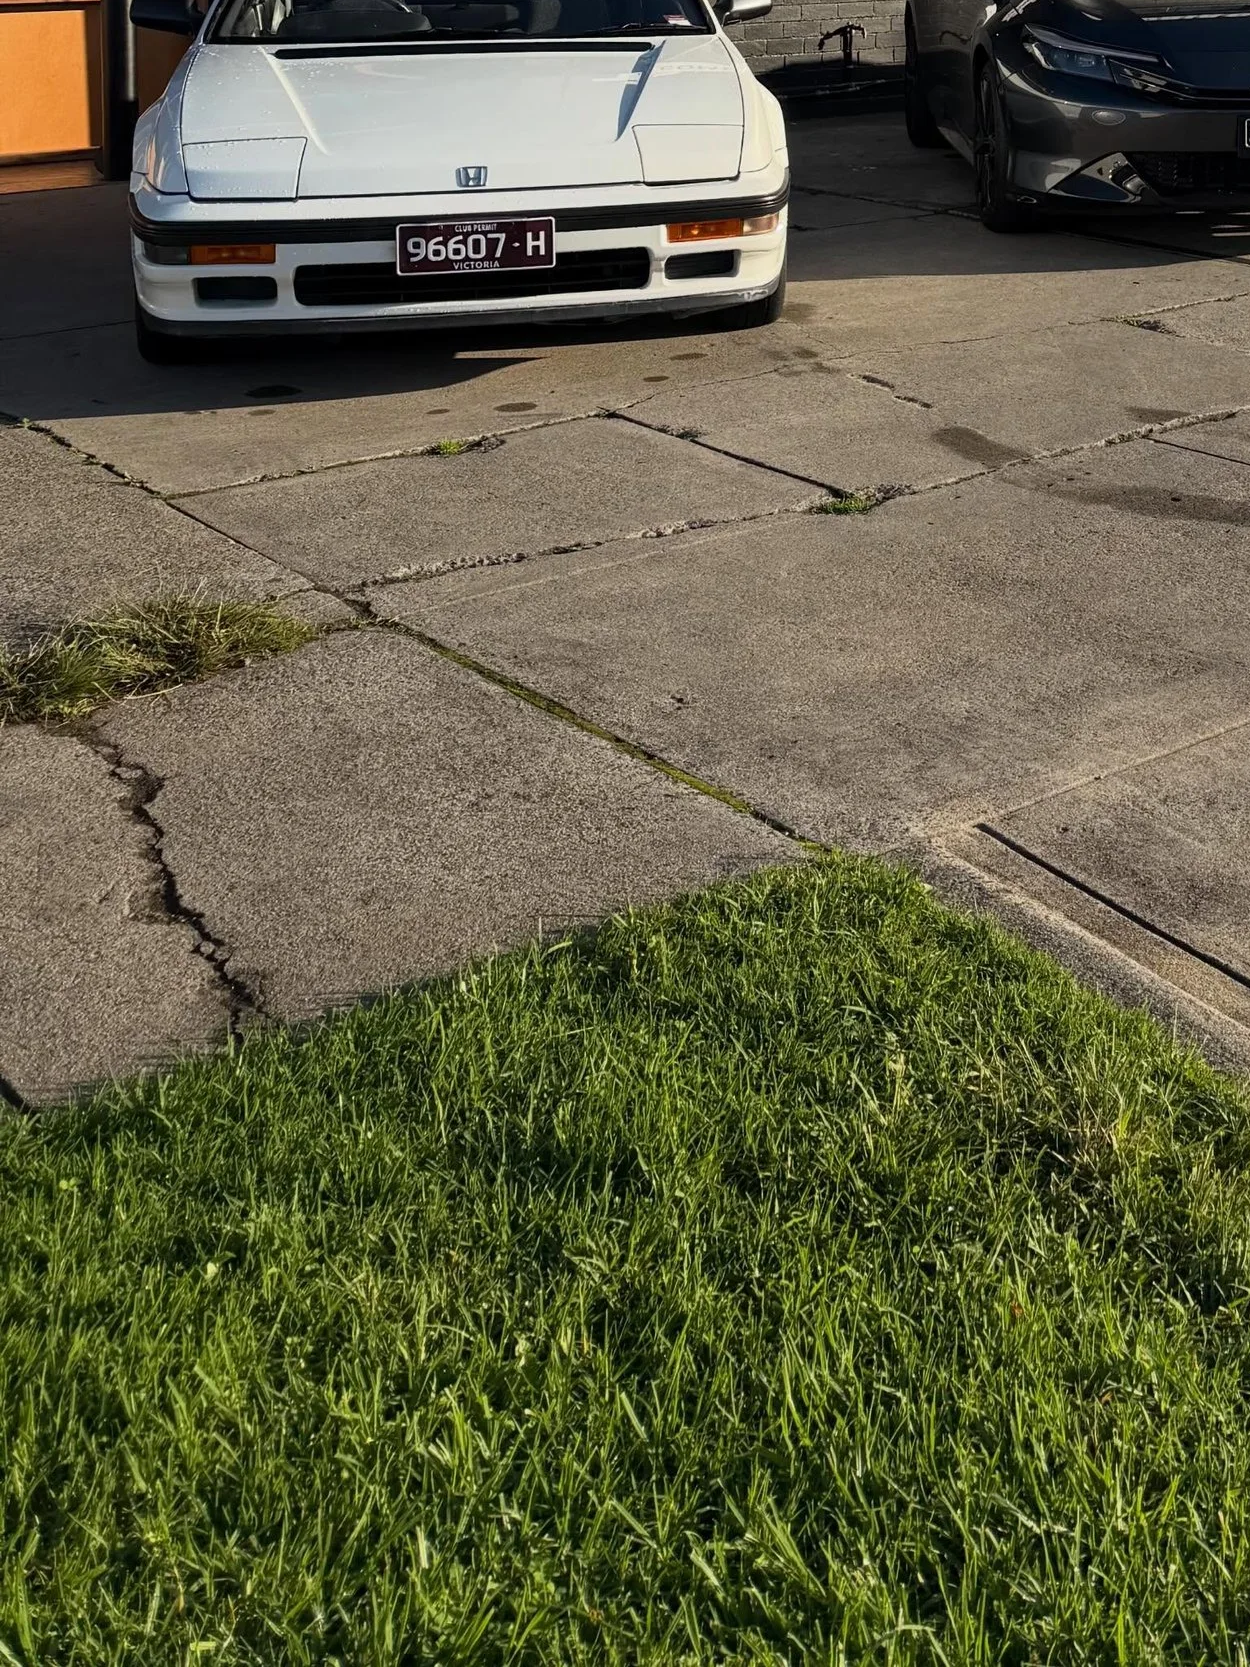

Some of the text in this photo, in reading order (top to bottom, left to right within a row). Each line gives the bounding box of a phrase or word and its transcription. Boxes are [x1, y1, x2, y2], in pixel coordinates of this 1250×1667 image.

[454, 223, 498, 232] CLUB PERMIT
[453, 260, 500, 270] VICTORIA
